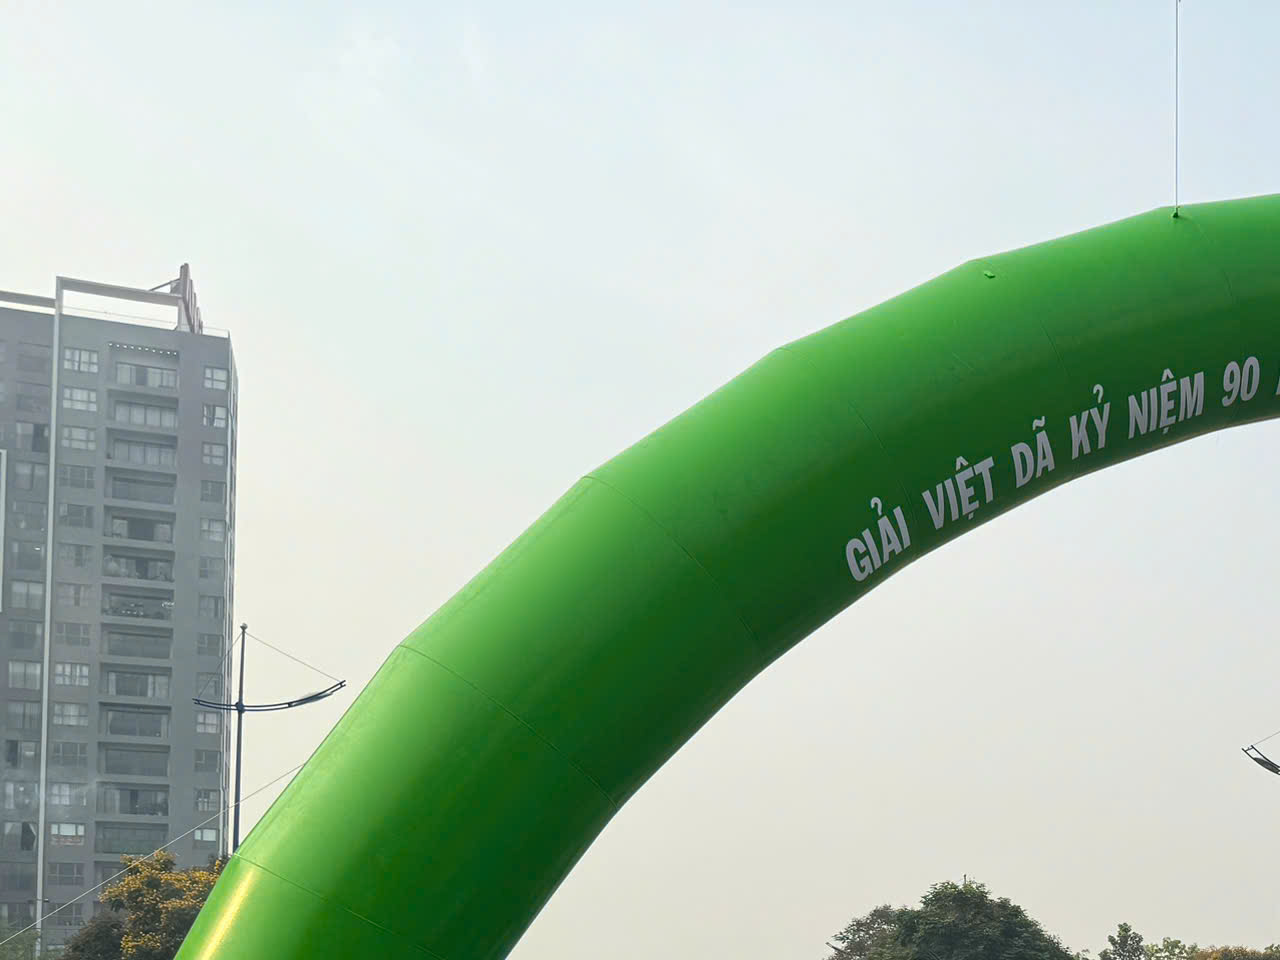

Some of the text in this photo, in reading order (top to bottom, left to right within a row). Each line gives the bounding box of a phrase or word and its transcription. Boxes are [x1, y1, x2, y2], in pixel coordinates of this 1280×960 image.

[846, 498, 910, 581] GIẢI
[922, 457, 993, 529] VIỆT
[1011, 416, 1055, 488] DÃ
[1070, 384, 1110, 460] KỶ
[1128, 369, 1204, 438] NIỆM
[1223, 357, 1260, 406] 90
